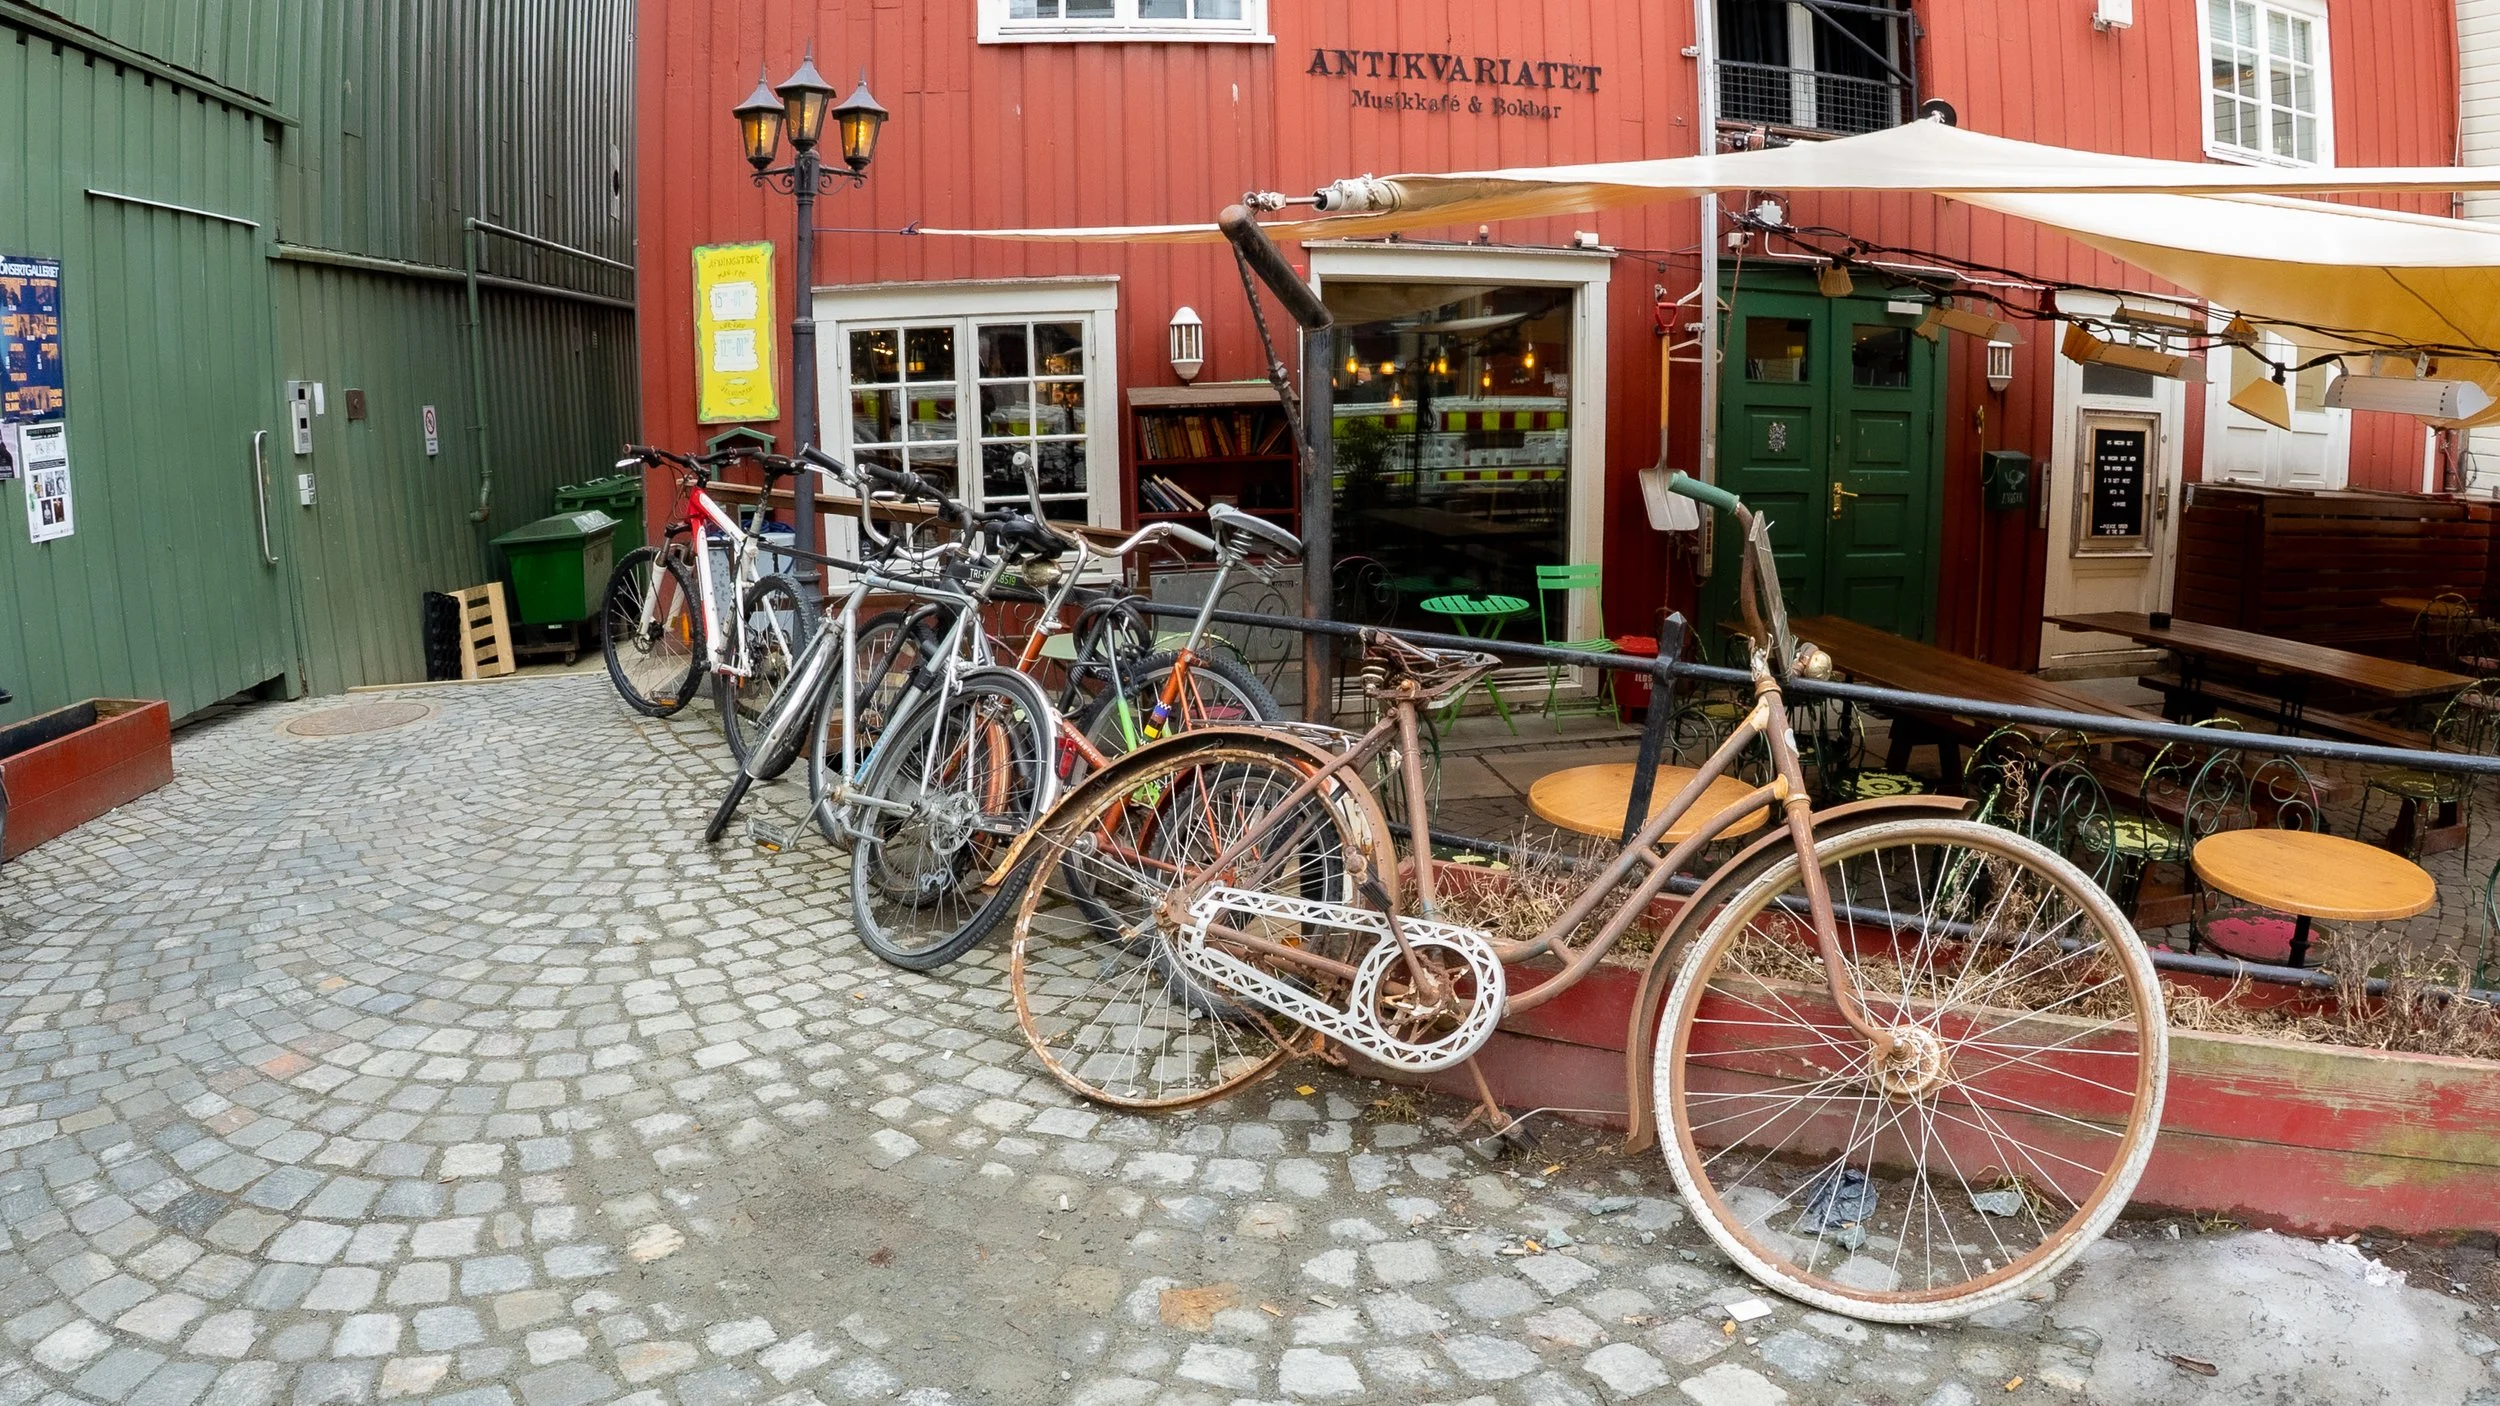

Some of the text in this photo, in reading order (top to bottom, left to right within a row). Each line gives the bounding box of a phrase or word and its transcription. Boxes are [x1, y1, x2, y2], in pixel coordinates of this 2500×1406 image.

[1306, 48, 1602, 93] ANTIKVARIATET
[1351, 89, 1562, 119] Musikkafé & Bokbar
[0, 263, 59, 278] ONSERTGALLERIET
[970, 568, 990, 580] TRI-M
[1635, 673, 1653, 682] ILDS
